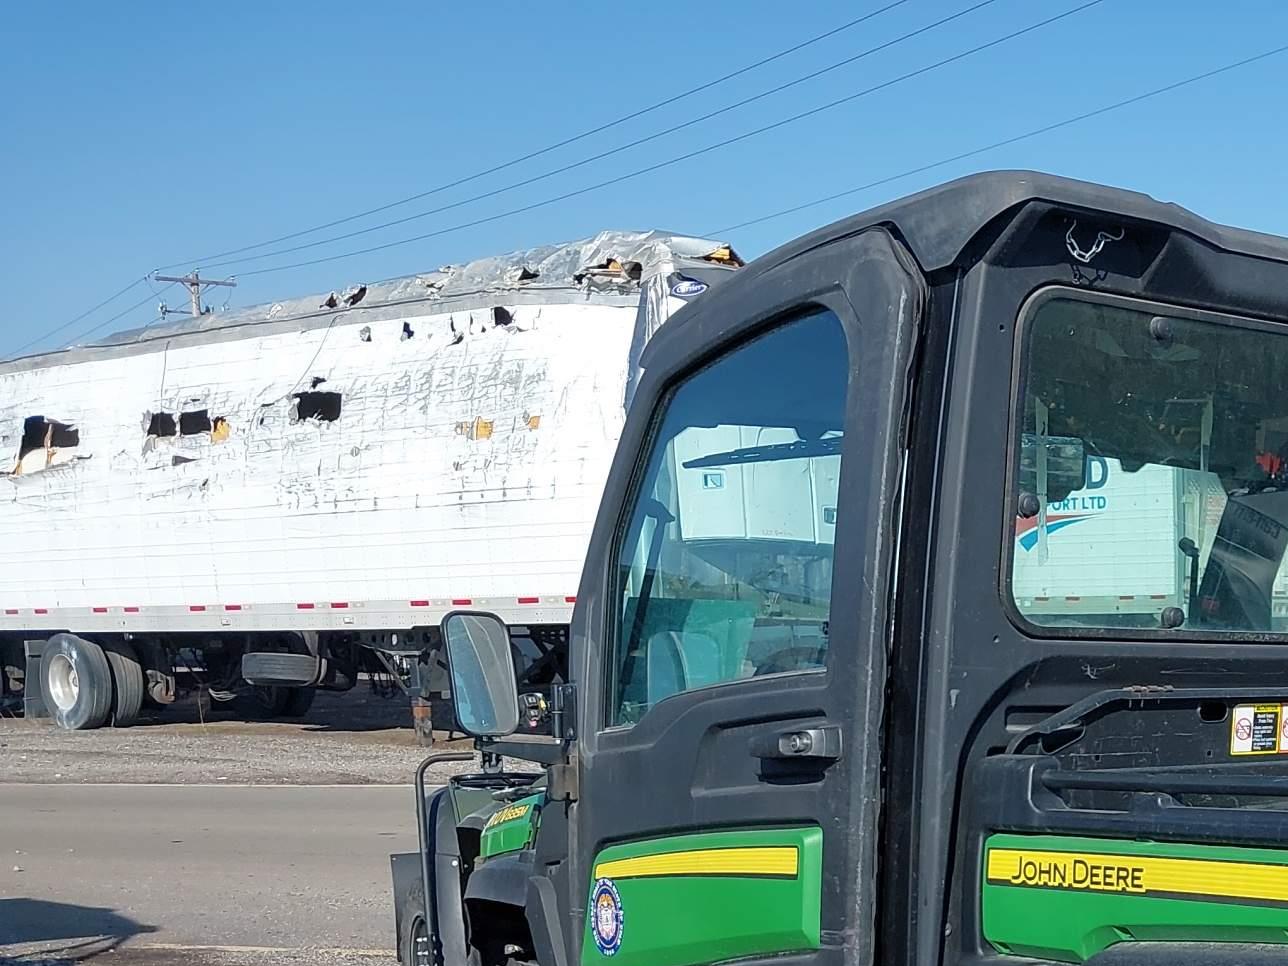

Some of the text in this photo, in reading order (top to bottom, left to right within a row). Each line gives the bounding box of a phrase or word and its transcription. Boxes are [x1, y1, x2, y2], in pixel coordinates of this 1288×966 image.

[1082, 496, 1107, 510] LTD
[1011, 855, 1144, 889] JOHN DEERE
